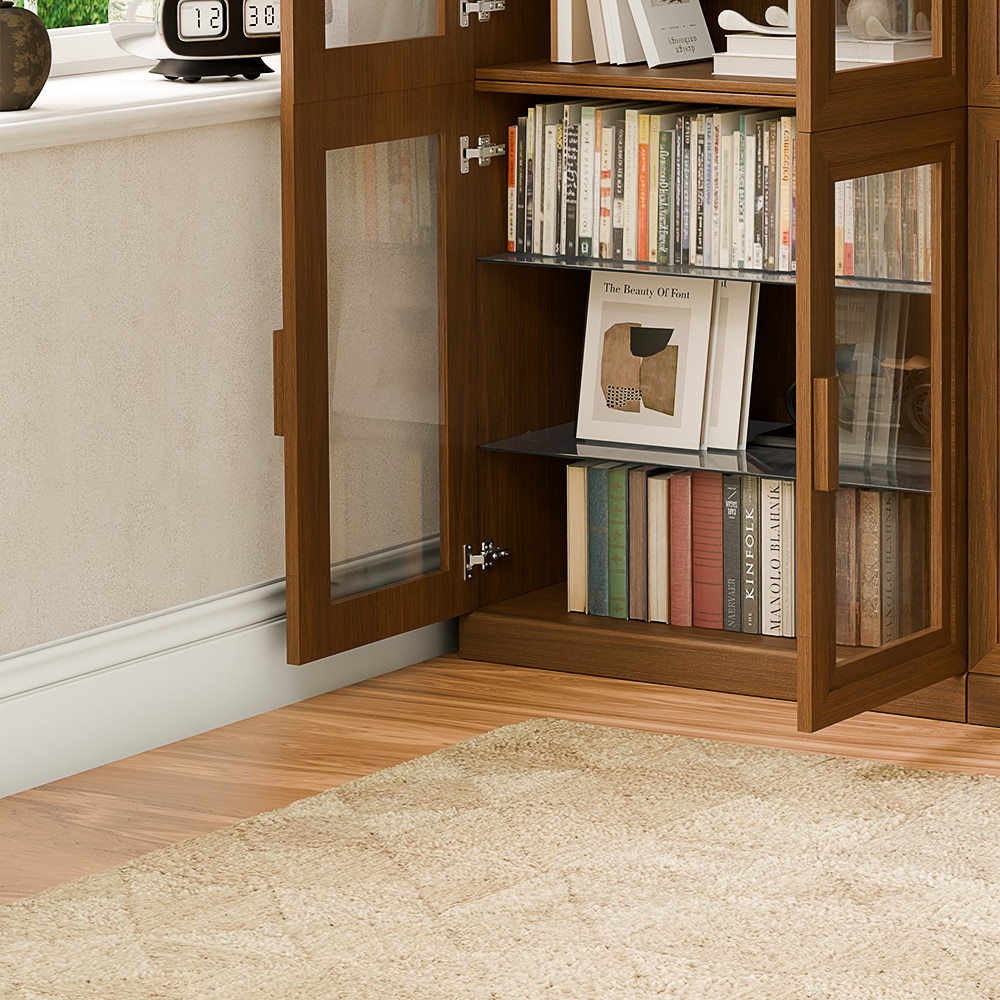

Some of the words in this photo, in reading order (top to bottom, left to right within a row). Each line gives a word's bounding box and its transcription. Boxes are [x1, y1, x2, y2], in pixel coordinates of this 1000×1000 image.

[196, 8, 220, 28] 12
[248, 5, 274, 26] 30
[603, 282, 621, 294] The
[624, 284, 654, 298] Beauty
[657, 287, 670, 297] Of
[671, 288, 690, 299] Font
[767, 485, 781, 551] BLAHNÍK
[745, 508, 754, 600] KINFOLK
[728, 578, 736, 627] NAERVAER
[769, 558, 781, 631] MANOLO
